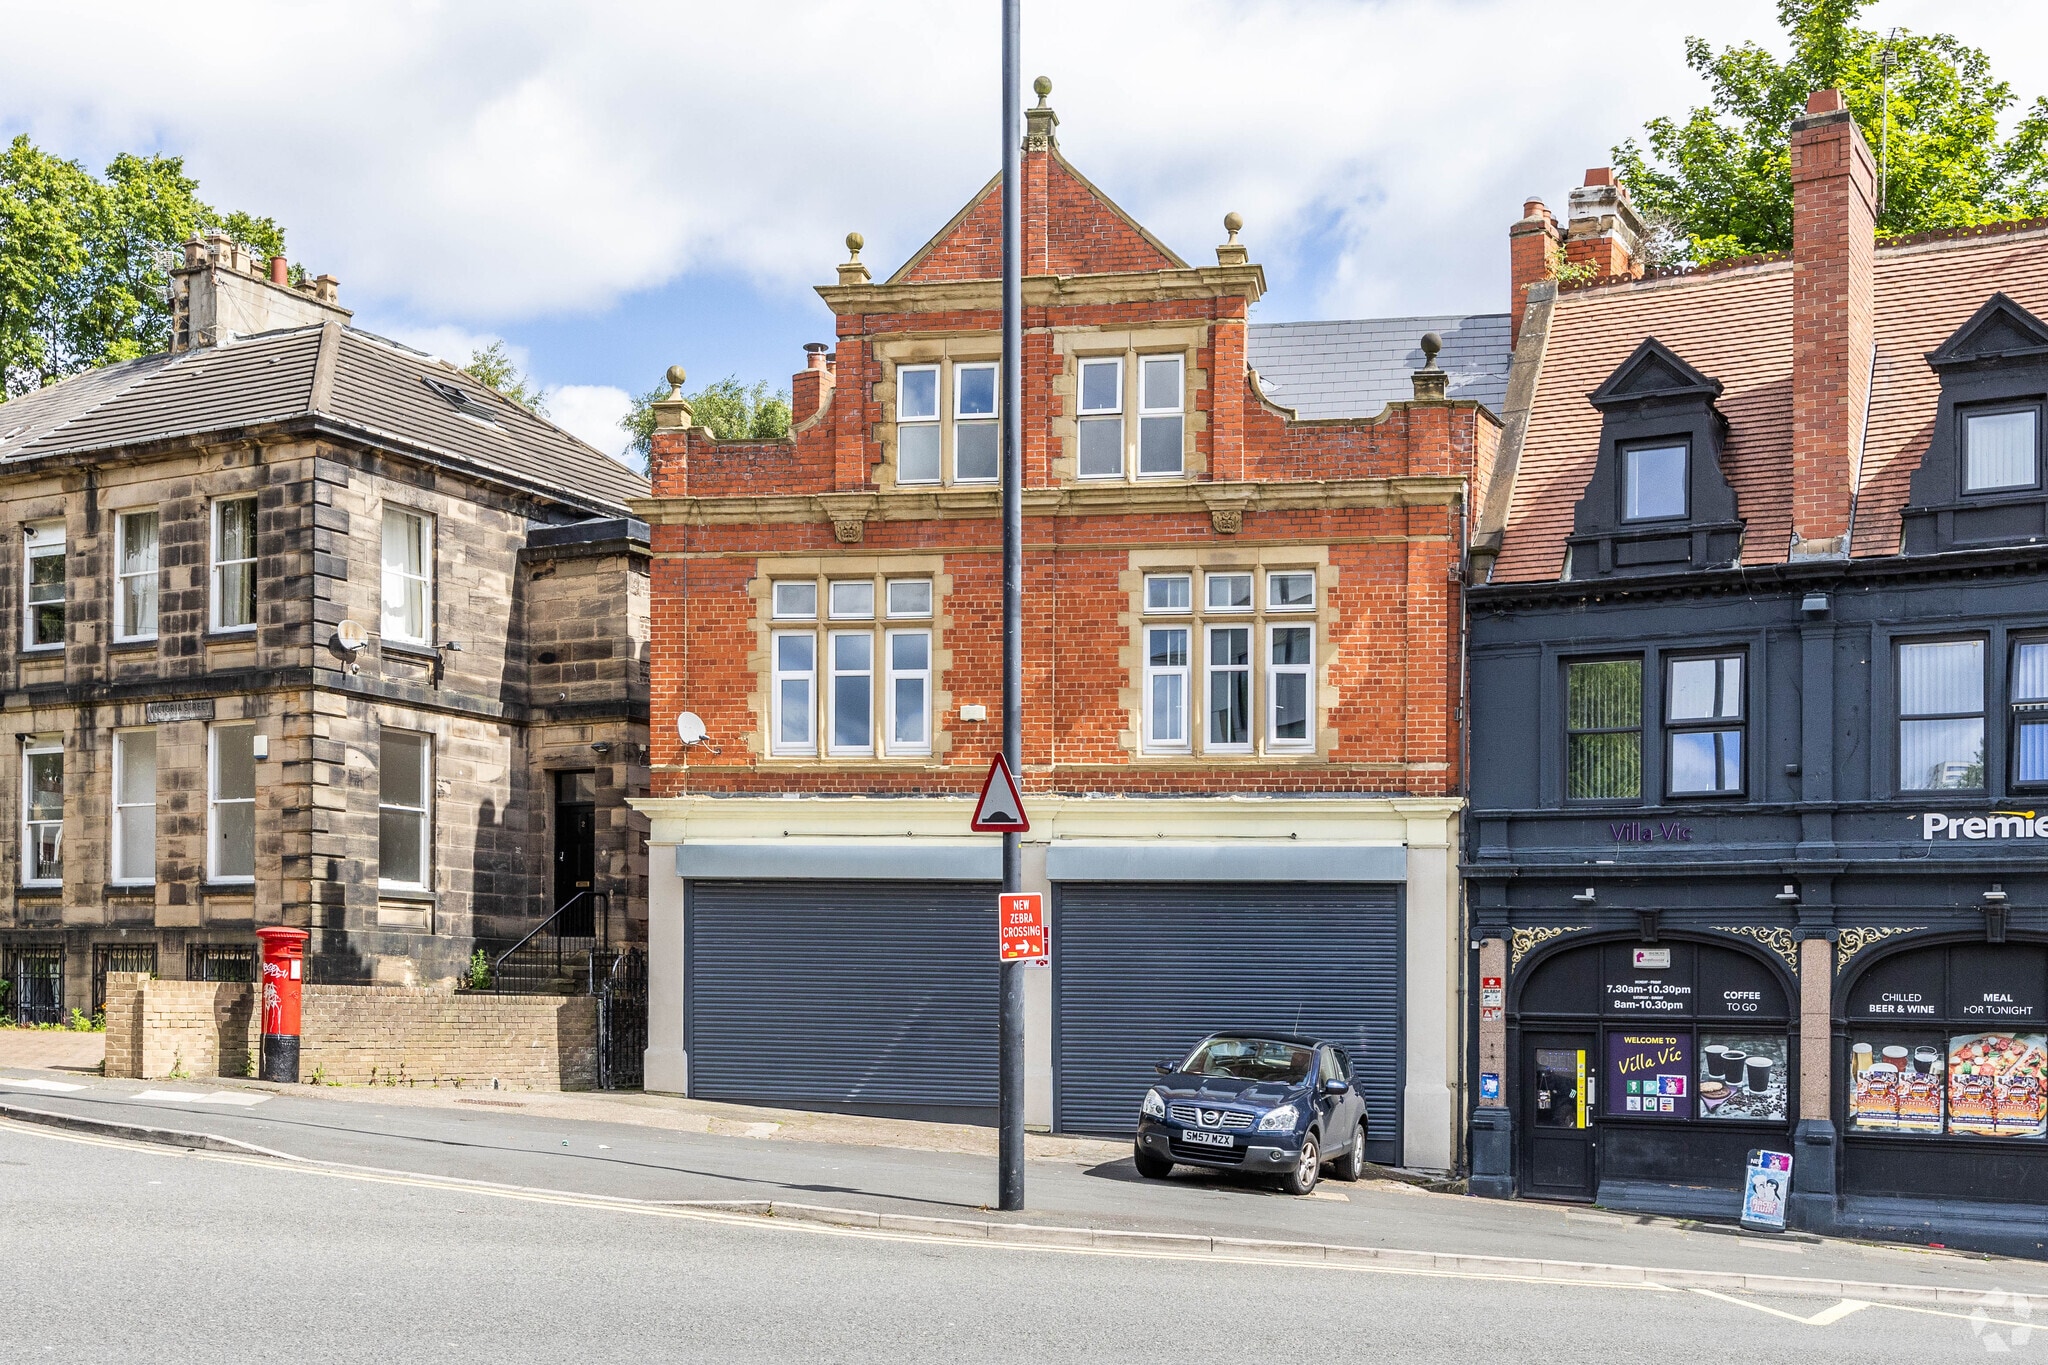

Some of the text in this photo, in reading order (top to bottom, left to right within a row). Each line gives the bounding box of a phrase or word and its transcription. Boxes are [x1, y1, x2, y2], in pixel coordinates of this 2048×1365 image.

[150, 702, 210, 713] VICTORIA STREET
[1610, 822, 1692, 841] Villa Vic
[1013, 900, 1030, 910] NEW
[1010, 912, 1033, 924] ZEBRA
[1003, 925, 1040, 938] CROSSING
[1606, 984, 1691, 996] 7.30am-10.30pm
[1724, 991, 1760, 1000] COFFEE
[1882, 993, 1922, 1002] CHILLED
[1984, 994, 2013, 1002] MEAL
[1614, 1000, 1683, 1011] 8am-10.30pm
[1726, 1002, 1758, 1012] TO GO
[1869, 1004, 1935, 1014] BEER & WINE
[1964, 1006, 2033, 1014] FOR TONIGHT
[1618, 1046, 1682, 1074] Villa Vic
[1186, 1132, 1230, 1144] SM57 MZX
